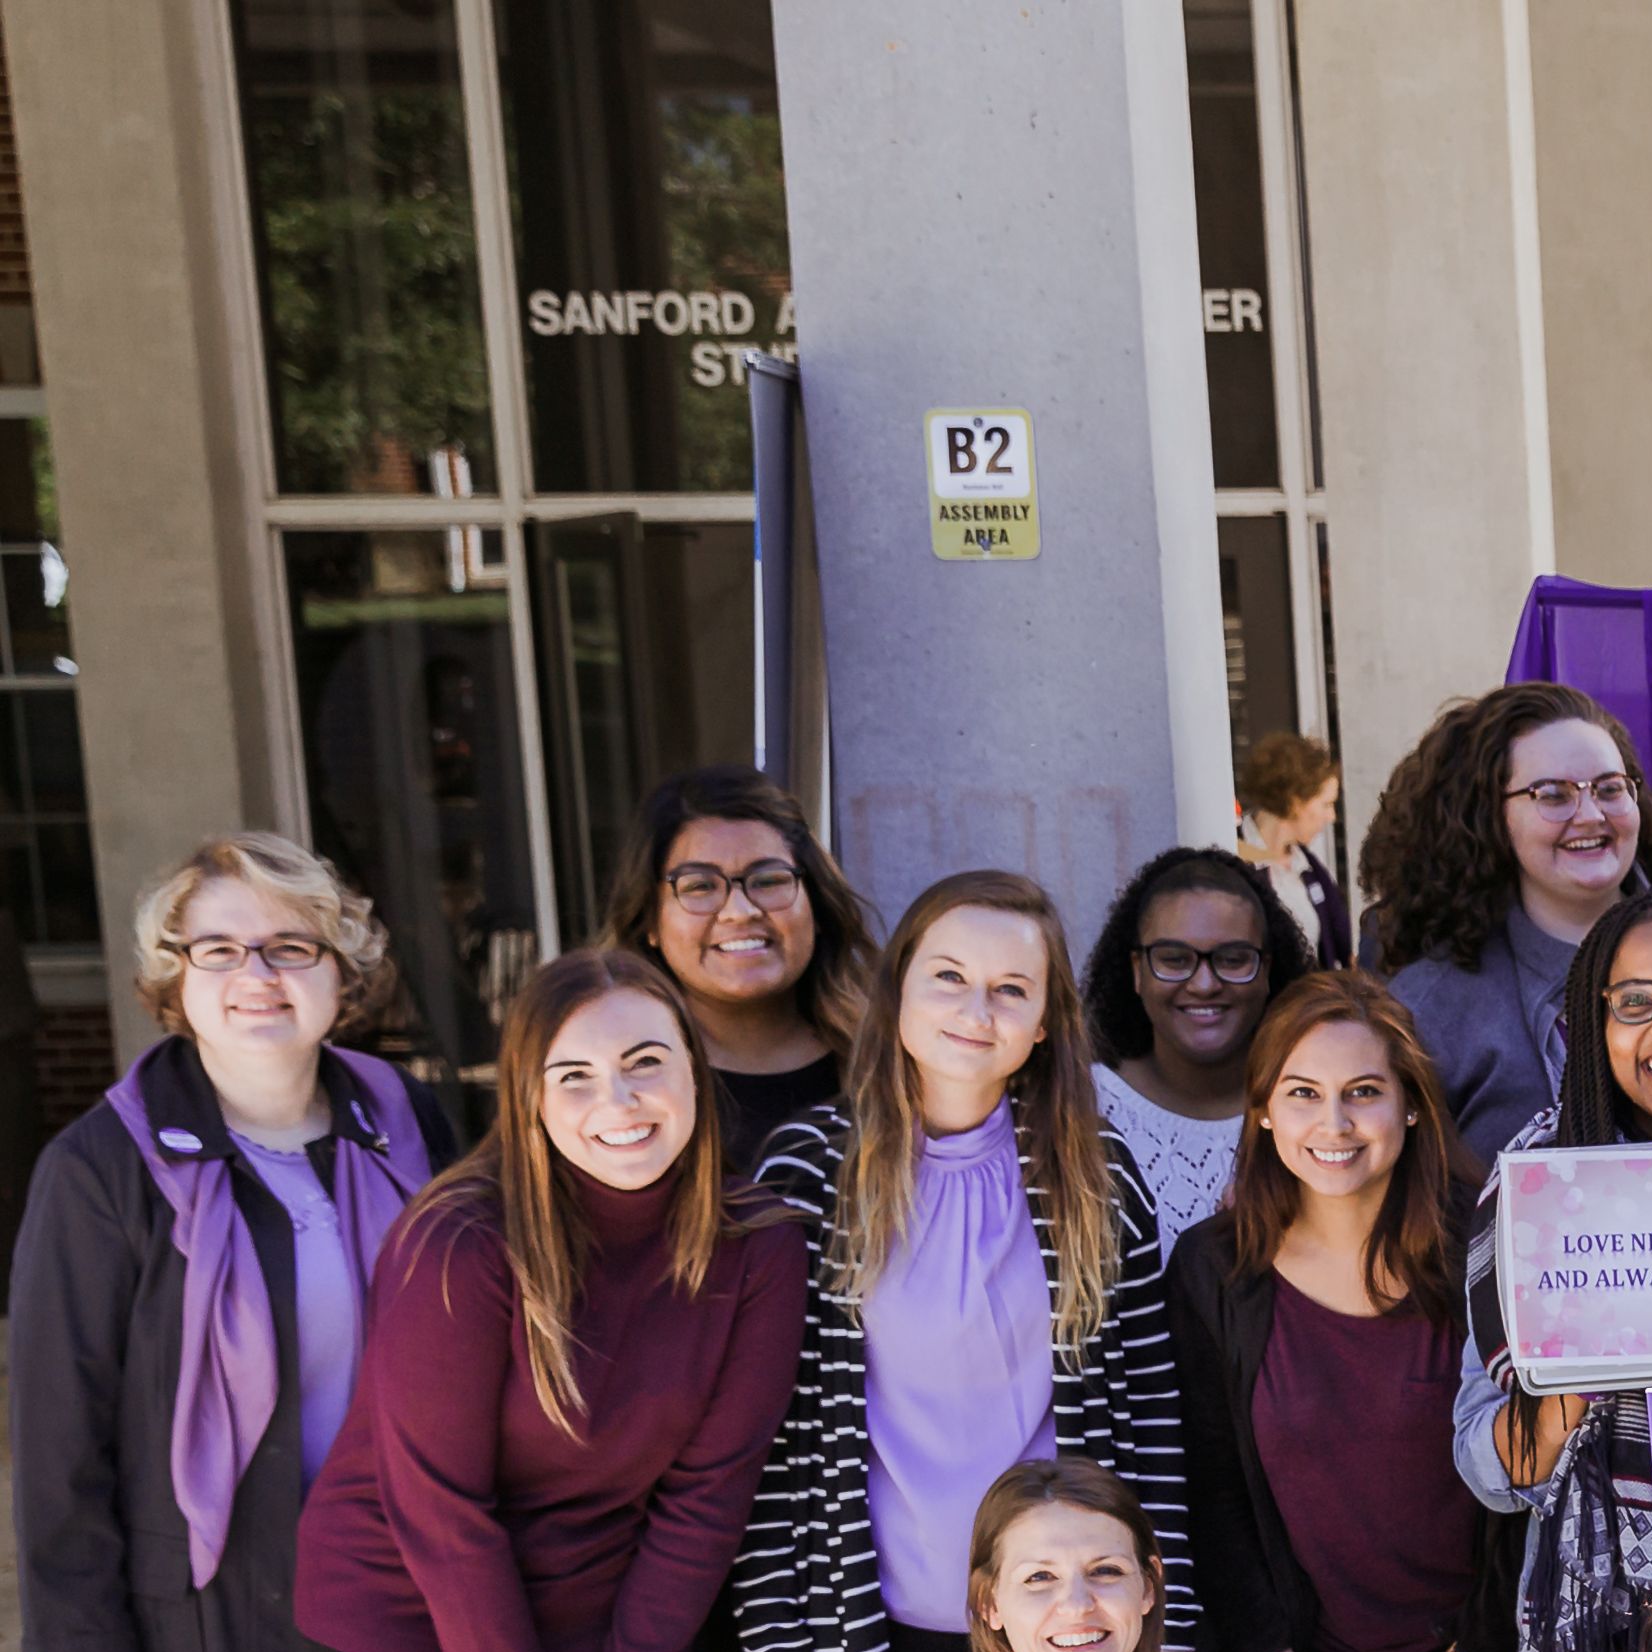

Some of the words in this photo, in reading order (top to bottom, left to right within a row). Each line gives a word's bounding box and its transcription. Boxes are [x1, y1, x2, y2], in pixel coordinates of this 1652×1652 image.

[529, 288, 755, 336] SANFORD
[946, 426, 1013, 474] B2
[938, 504, 1031, 522] ASSEMBLY
[963, 528, 1010, 546] AREA
[1562, 1233, 1625, 1255] LOVE
[1537, 1269, 1590, 1290] AND
